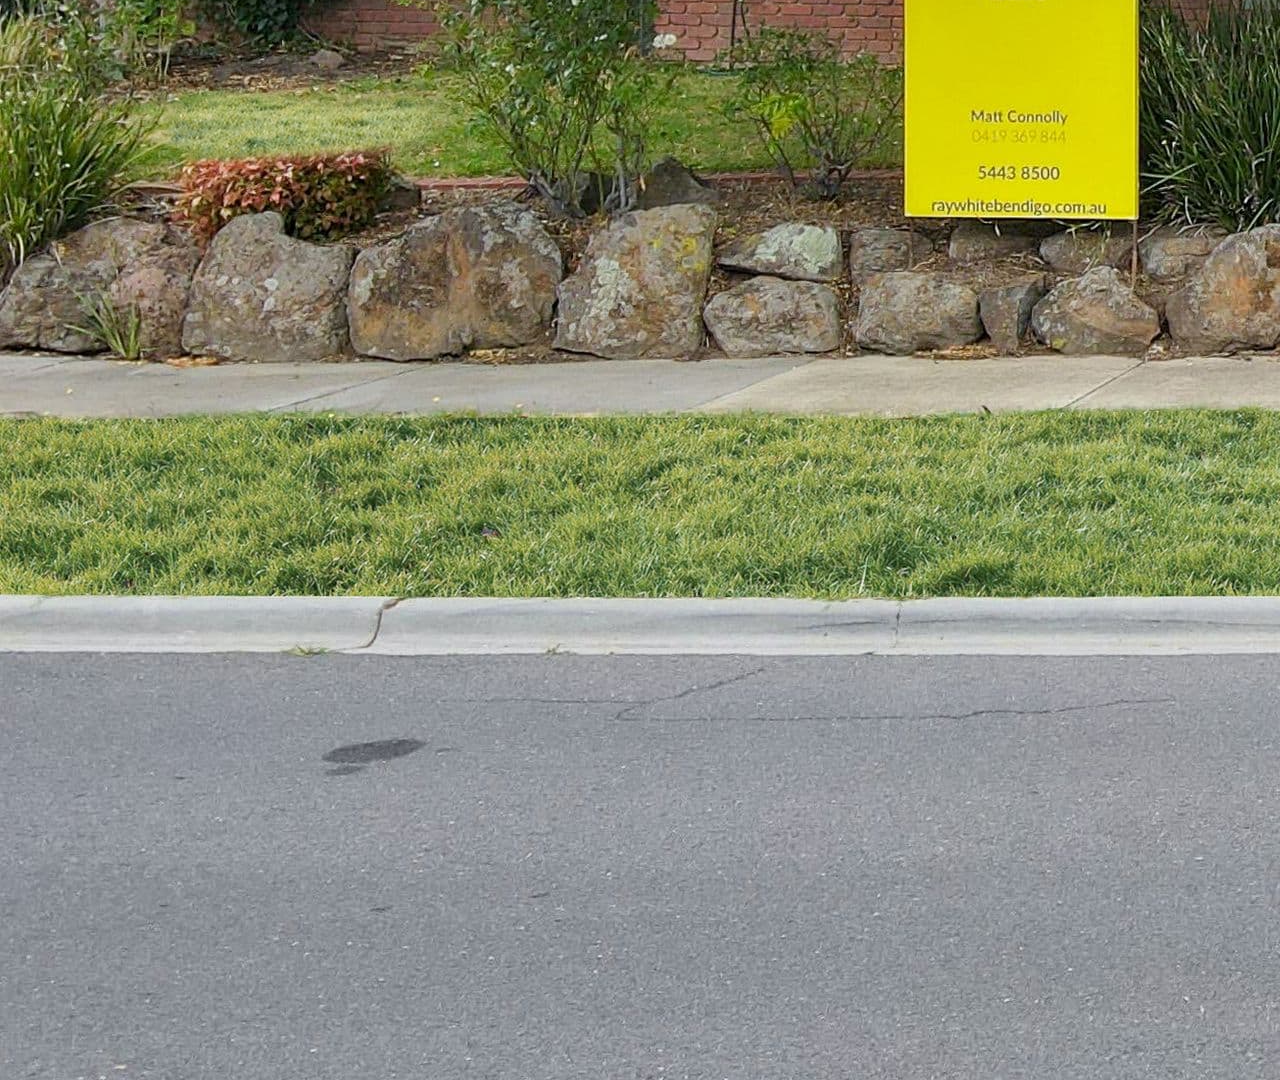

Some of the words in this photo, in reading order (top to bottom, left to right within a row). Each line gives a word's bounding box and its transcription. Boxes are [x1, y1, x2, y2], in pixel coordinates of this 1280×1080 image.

[971, 110, 1003, 123] Matt
[1007, 110, 1068, 125] Connolly
[978, 165, 1016, 180] 5443
[1020, 165, 1060, 180] 8500
[931, 198, 1107, 216] raywhitebendigo.com.au
